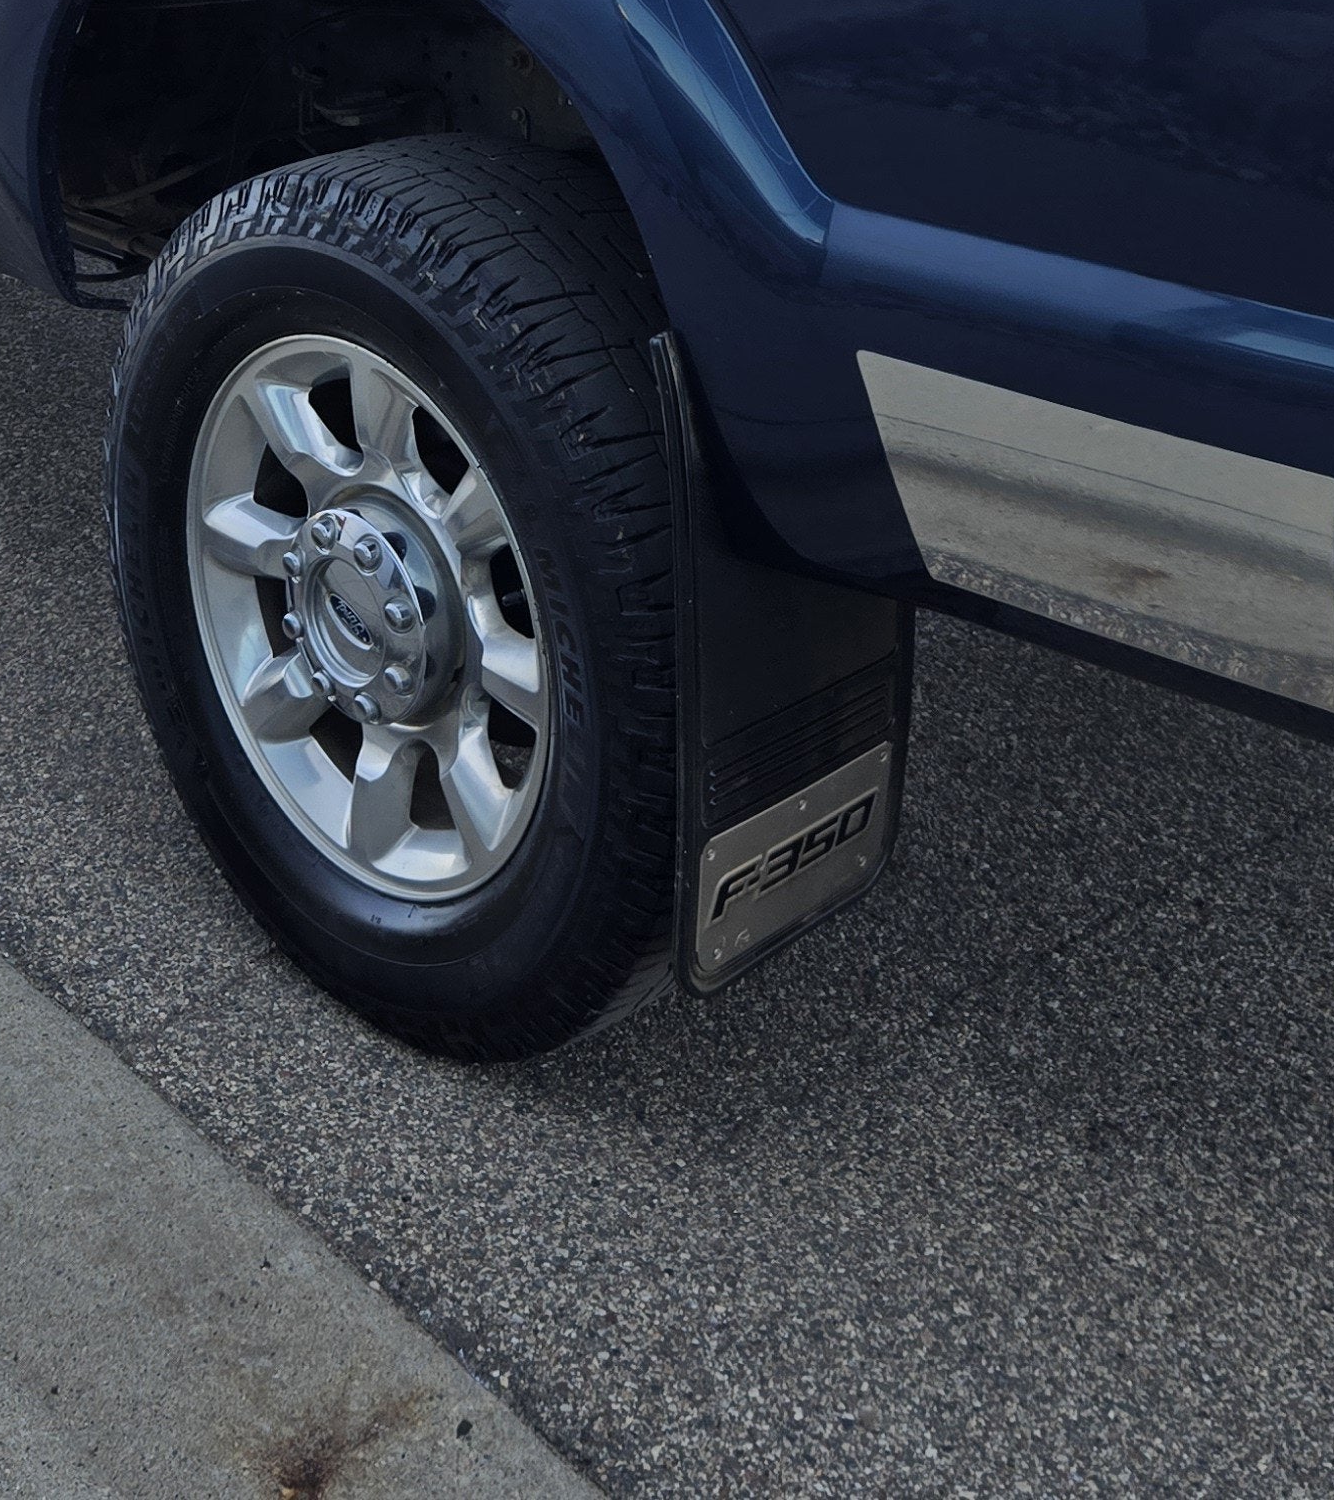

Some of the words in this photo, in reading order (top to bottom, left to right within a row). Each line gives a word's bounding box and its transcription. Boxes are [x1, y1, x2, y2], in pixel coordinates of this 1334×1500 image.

[335, 599, 365, 636] Ford
[534, 546, 588, 806] MICHE
[707, 786, 879, 927] F-350
